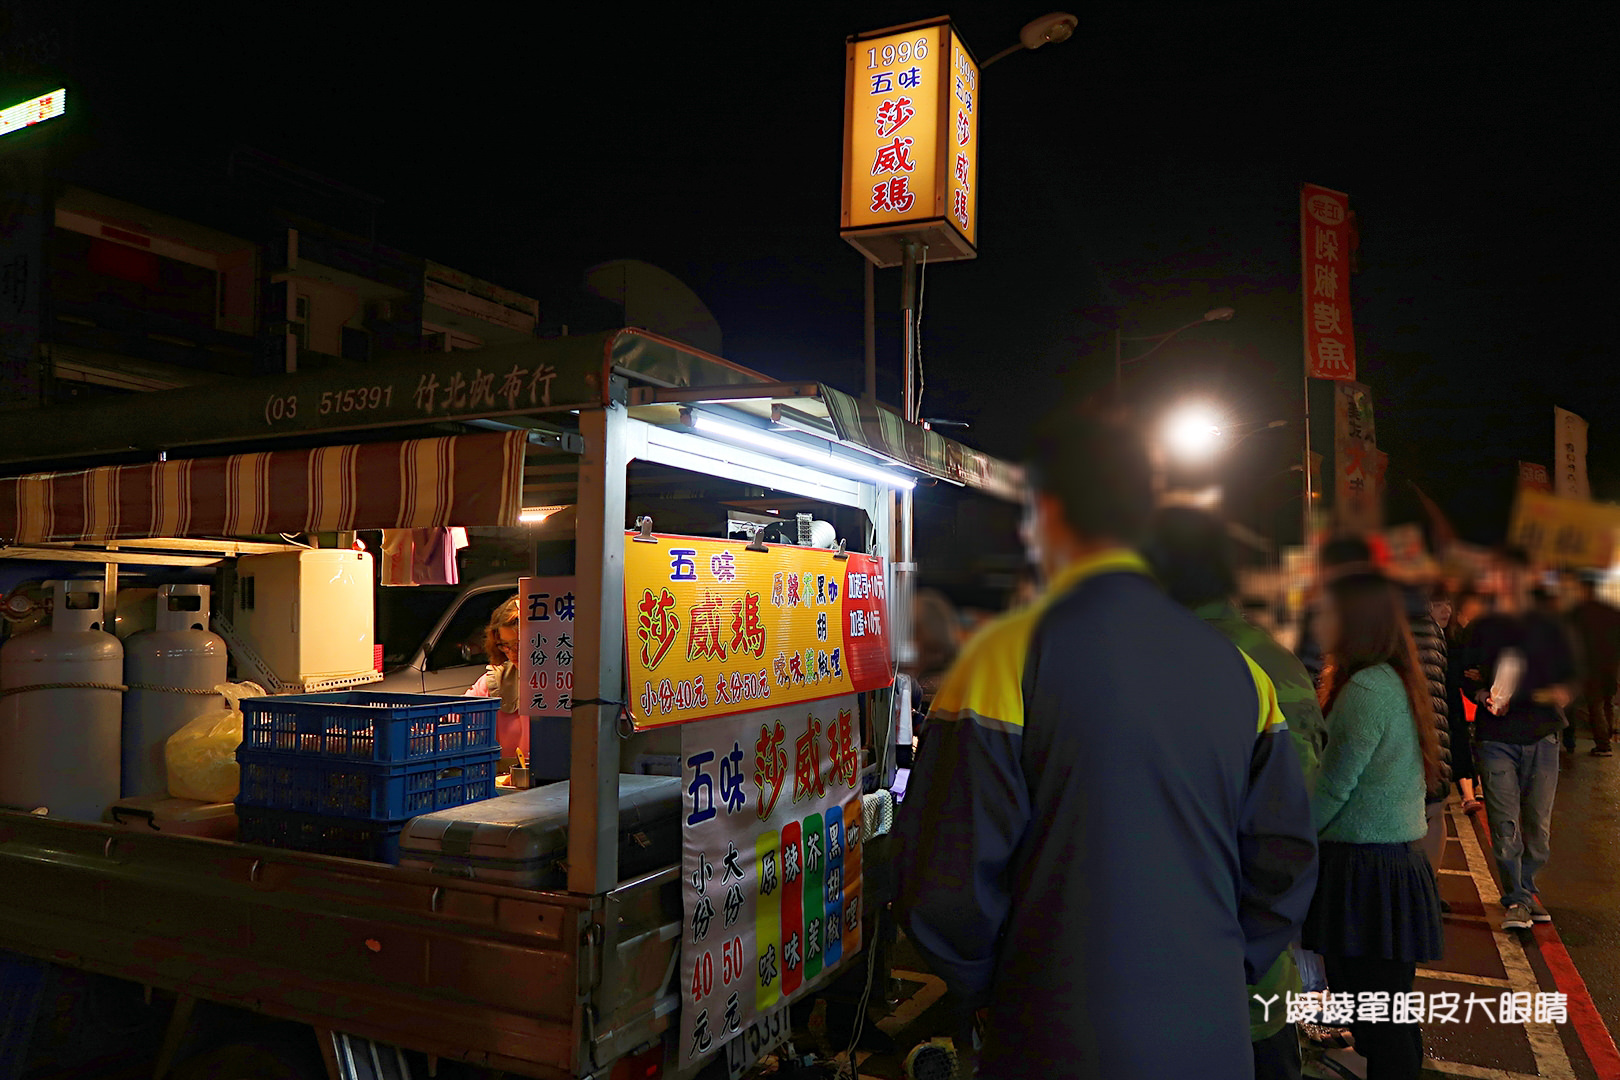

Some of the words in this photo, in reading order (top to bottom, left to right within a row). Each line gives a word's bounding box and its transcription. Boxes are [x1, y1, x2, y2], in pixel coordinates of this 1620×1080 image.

[867, 38, 929, 70] 1996
[954, 46, 975, 91] 1996
[870, 66, 921, 96] 五味
[870, 96, 916, 213] 莎威瑪
[954, 109, 970, 230] 莎威瑪
[413, 364, 558, 415] 竹北帆布行
[668, 548, 736, 583] 五味
[527, 592, 575, 622] 五味
[637, 588, 766, 671] 莎威瑪
[640, 674, 708, 717] 小份40元
[714, 668, 771, 706] 大份50元
[686, 741, 746, 826] 五味
[755, 708, 858, 821] 莎威瑪
[827, 821, 842, 949] 黑胡椒
